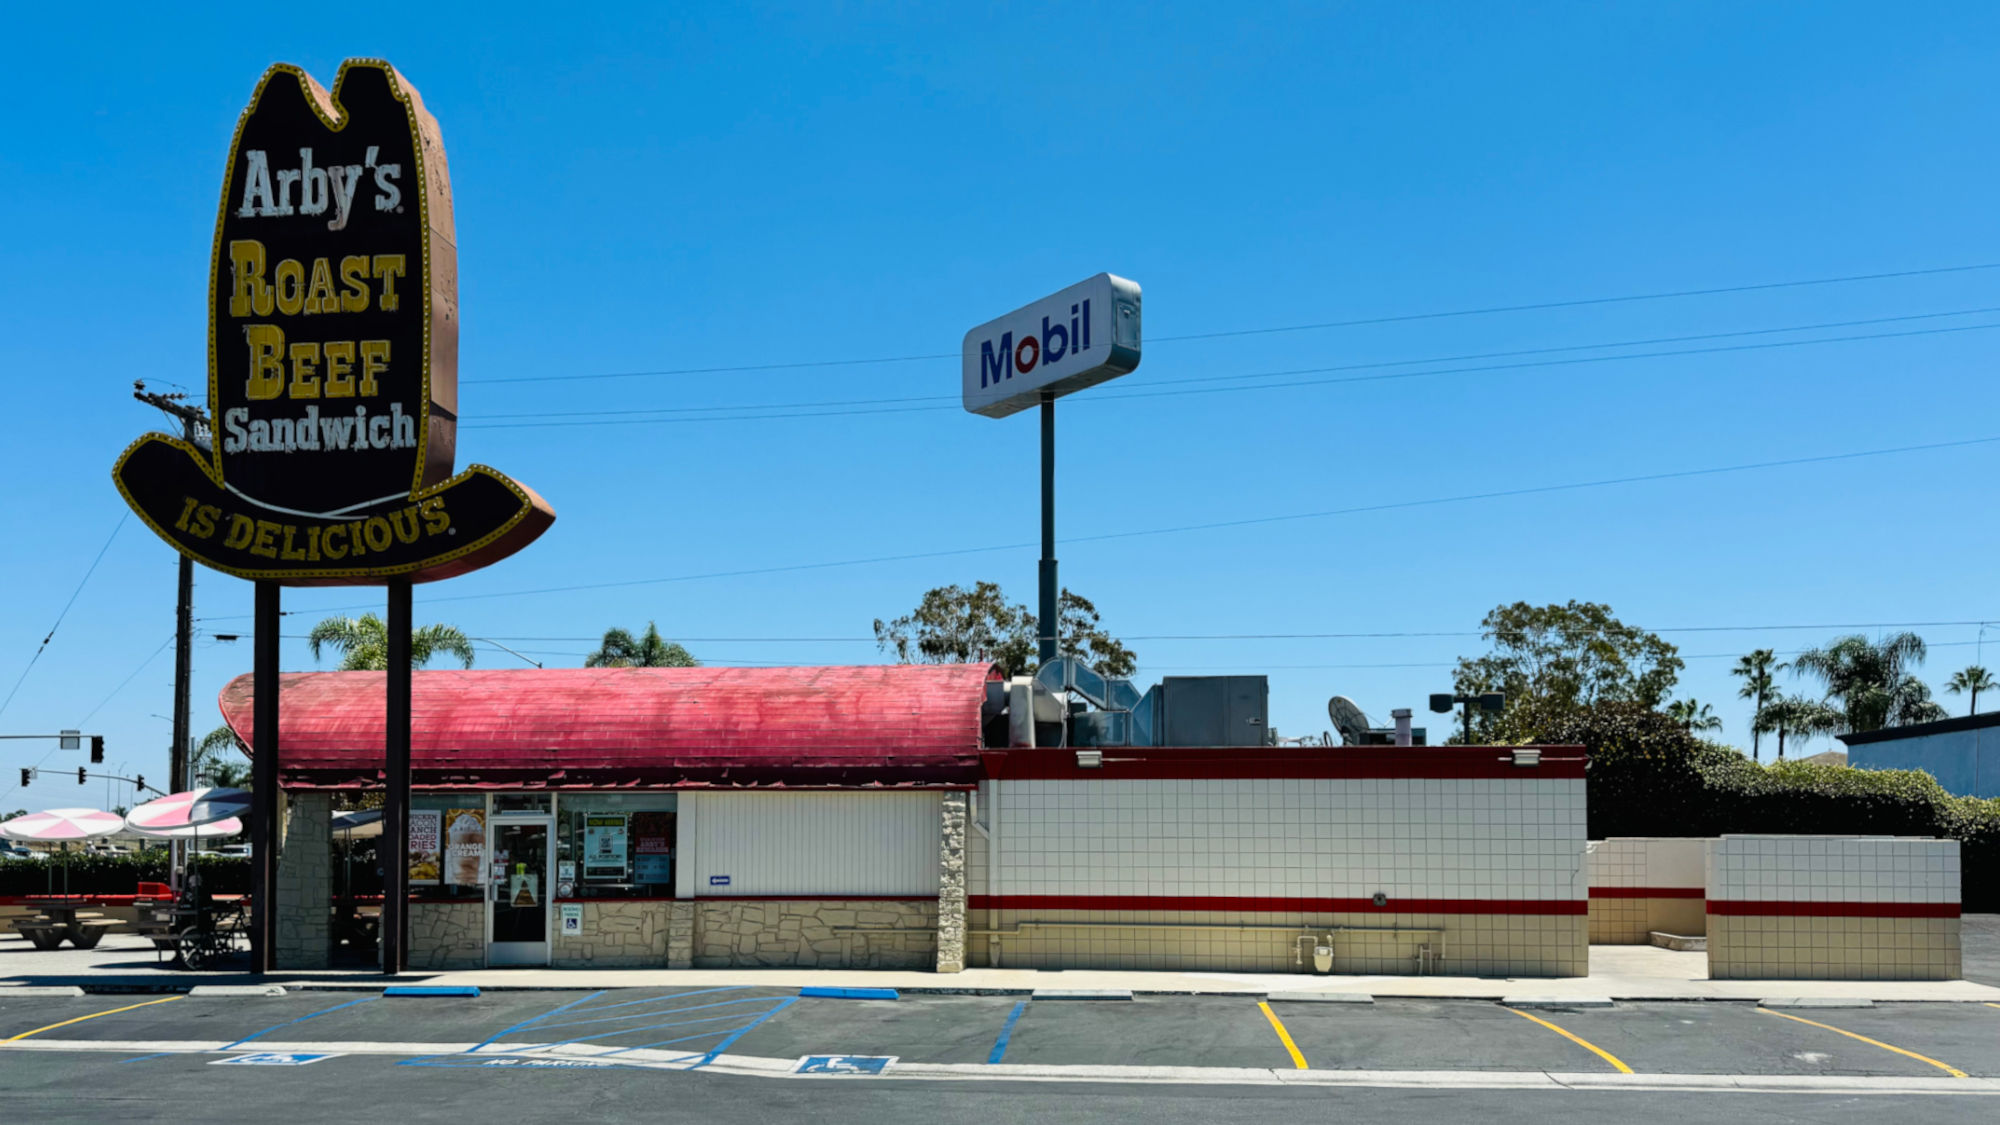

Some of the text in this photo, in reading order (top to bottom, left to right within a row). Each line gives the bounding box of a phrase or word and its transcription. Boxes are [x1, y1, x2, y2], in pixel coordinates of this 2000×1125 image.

[236, 146, 402, 231] Arby's
[229, 239, 406, 317] ROAST
[243, 324, 391, 400] BEEF
[980, 298, 1091, 389] Mobil
[223, 402, 417, 454] Sandwich
[175, 496, 451, 561] IS DELICIOUS
